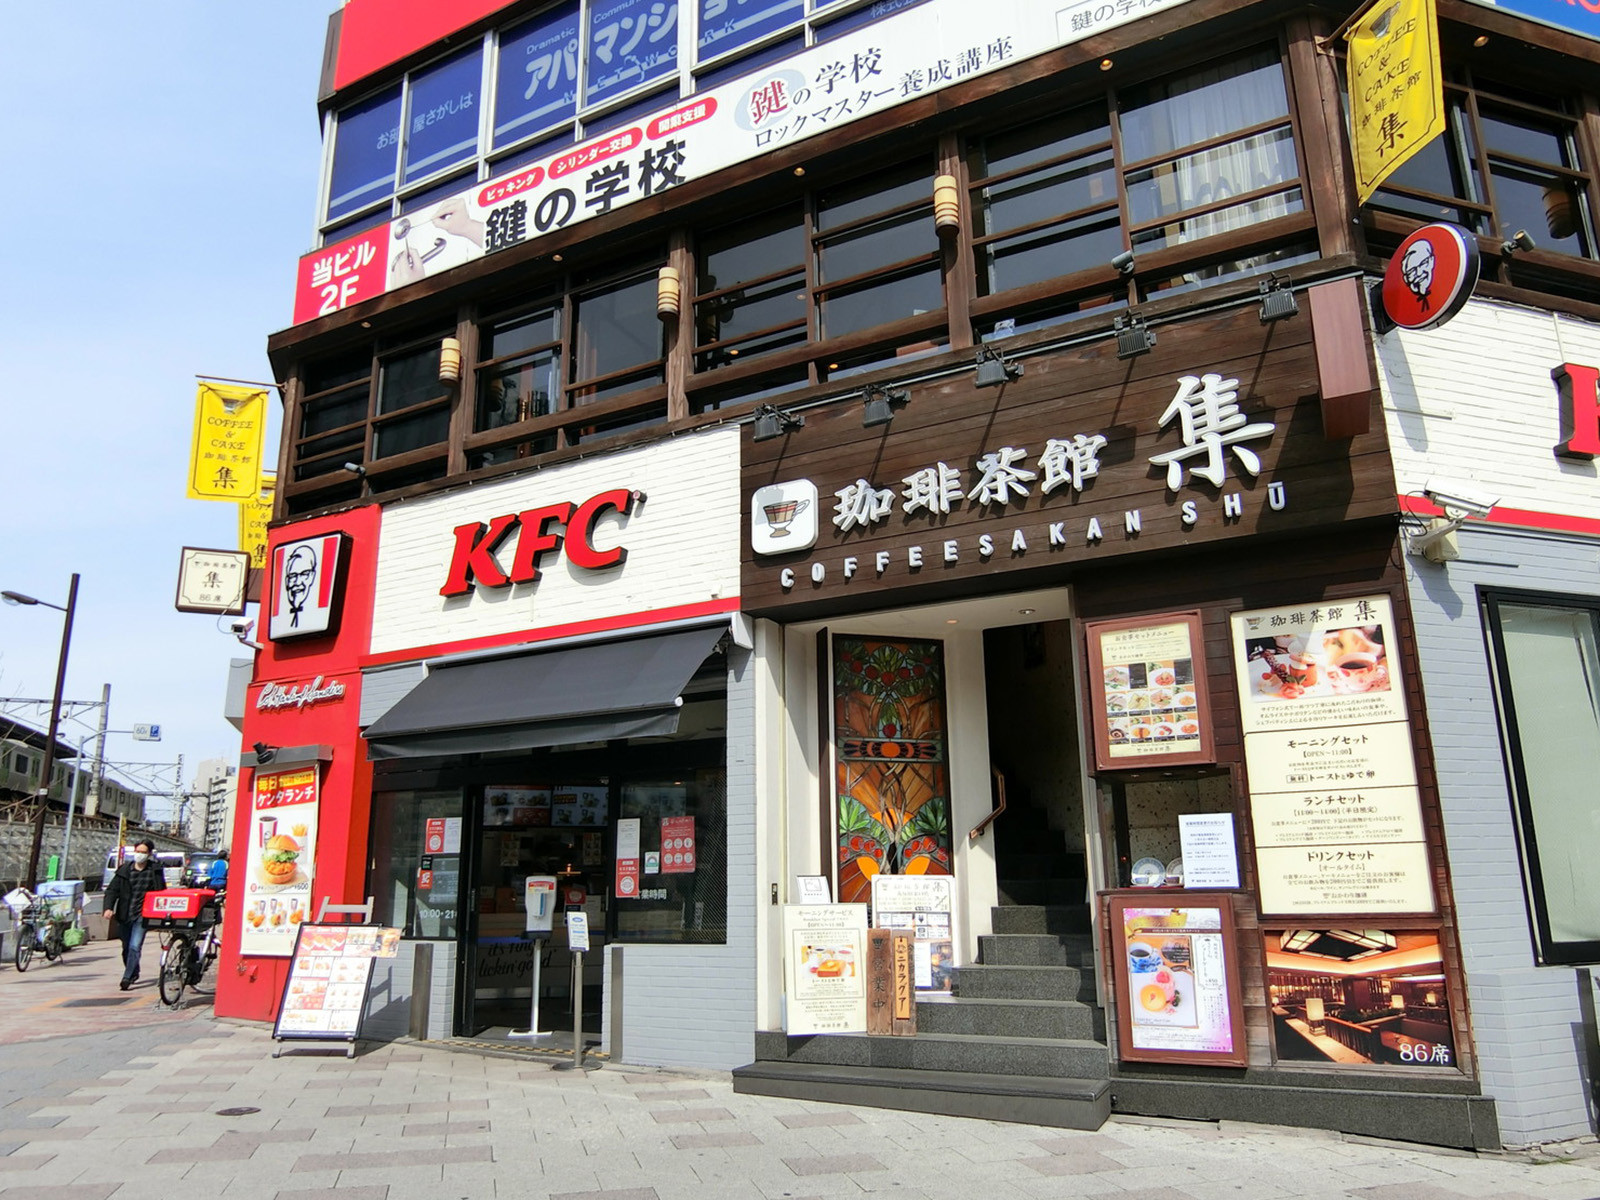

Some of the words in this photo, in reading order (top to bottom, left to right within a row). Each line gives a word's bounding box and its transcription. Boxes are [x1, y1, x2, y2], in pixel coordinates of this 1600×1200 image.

[527, 27, 576, 55] Dramatic
[750, 47, 883, 124] 鍵の学校
[754, 35, 1014, 148] ロックマスター養成講座
[1365, 58, 1410, 102] CAKE
[1375, 112, 1408, 157] 集
[557, 134, 633, 174] シリンダー交換
[485, 139, 686, 254] 鍵の学校
[311, 241, 377, 288] 当ビル
[319, 275, 359, 317] 2F
[207, 416, 253, 429] COFFEE
[211, 439, 246, 450] CAKE
[832, 433, 1107, 532] 珈琲茶館
[1148, 373, 1275, 493] 集
[212, 466, 238, 489] 集
[1181, 481, 1287, 526] SHU
[439, 488, 633, 598] KFC
[202, 571, 223, 589] 集
[1270, 607, 1344, 627] 珈琲茶館
[1354, 600, 1377, 621] 集
[1287, 734, 1369, 748] モーニングセット
[1309, 770, 1375, 782] トーストとゆで卵
[257, 785, 314, 807] ケンタランチ
[1303, 793, 1365, 805] ランチセット
[1307, 850, 1375, 862] ドリンクセット
[897, 956, 907, 1012] ニカラグア
[1399, 1043, 1450, 1064] 86席
